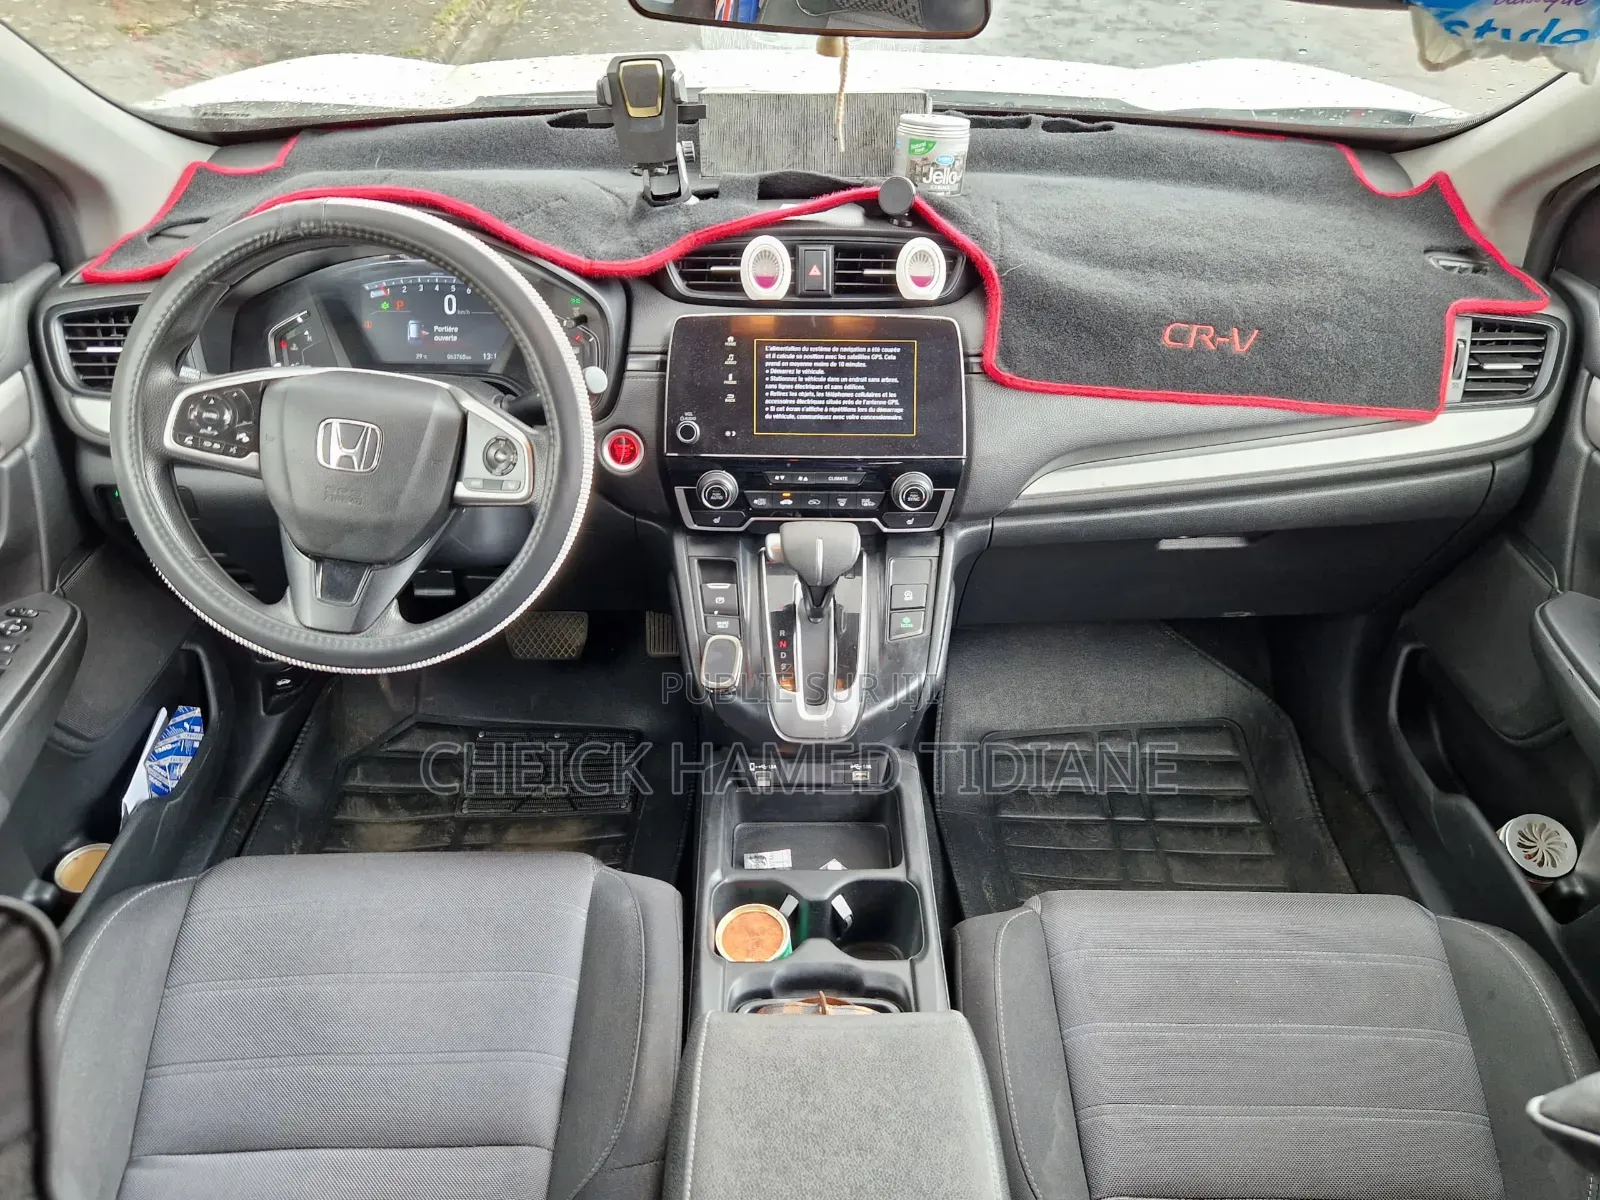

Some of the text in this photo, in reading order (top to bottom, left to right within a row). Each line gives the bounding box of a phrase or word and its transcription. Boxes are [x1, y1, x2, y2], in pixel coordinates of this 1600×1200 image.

[922, 166, 957, 184] Jello
[443, 294, 457, 315] 0
[1163, 322, 1260, 352] CR-V
[482, 352, 498, 360] 13:1
